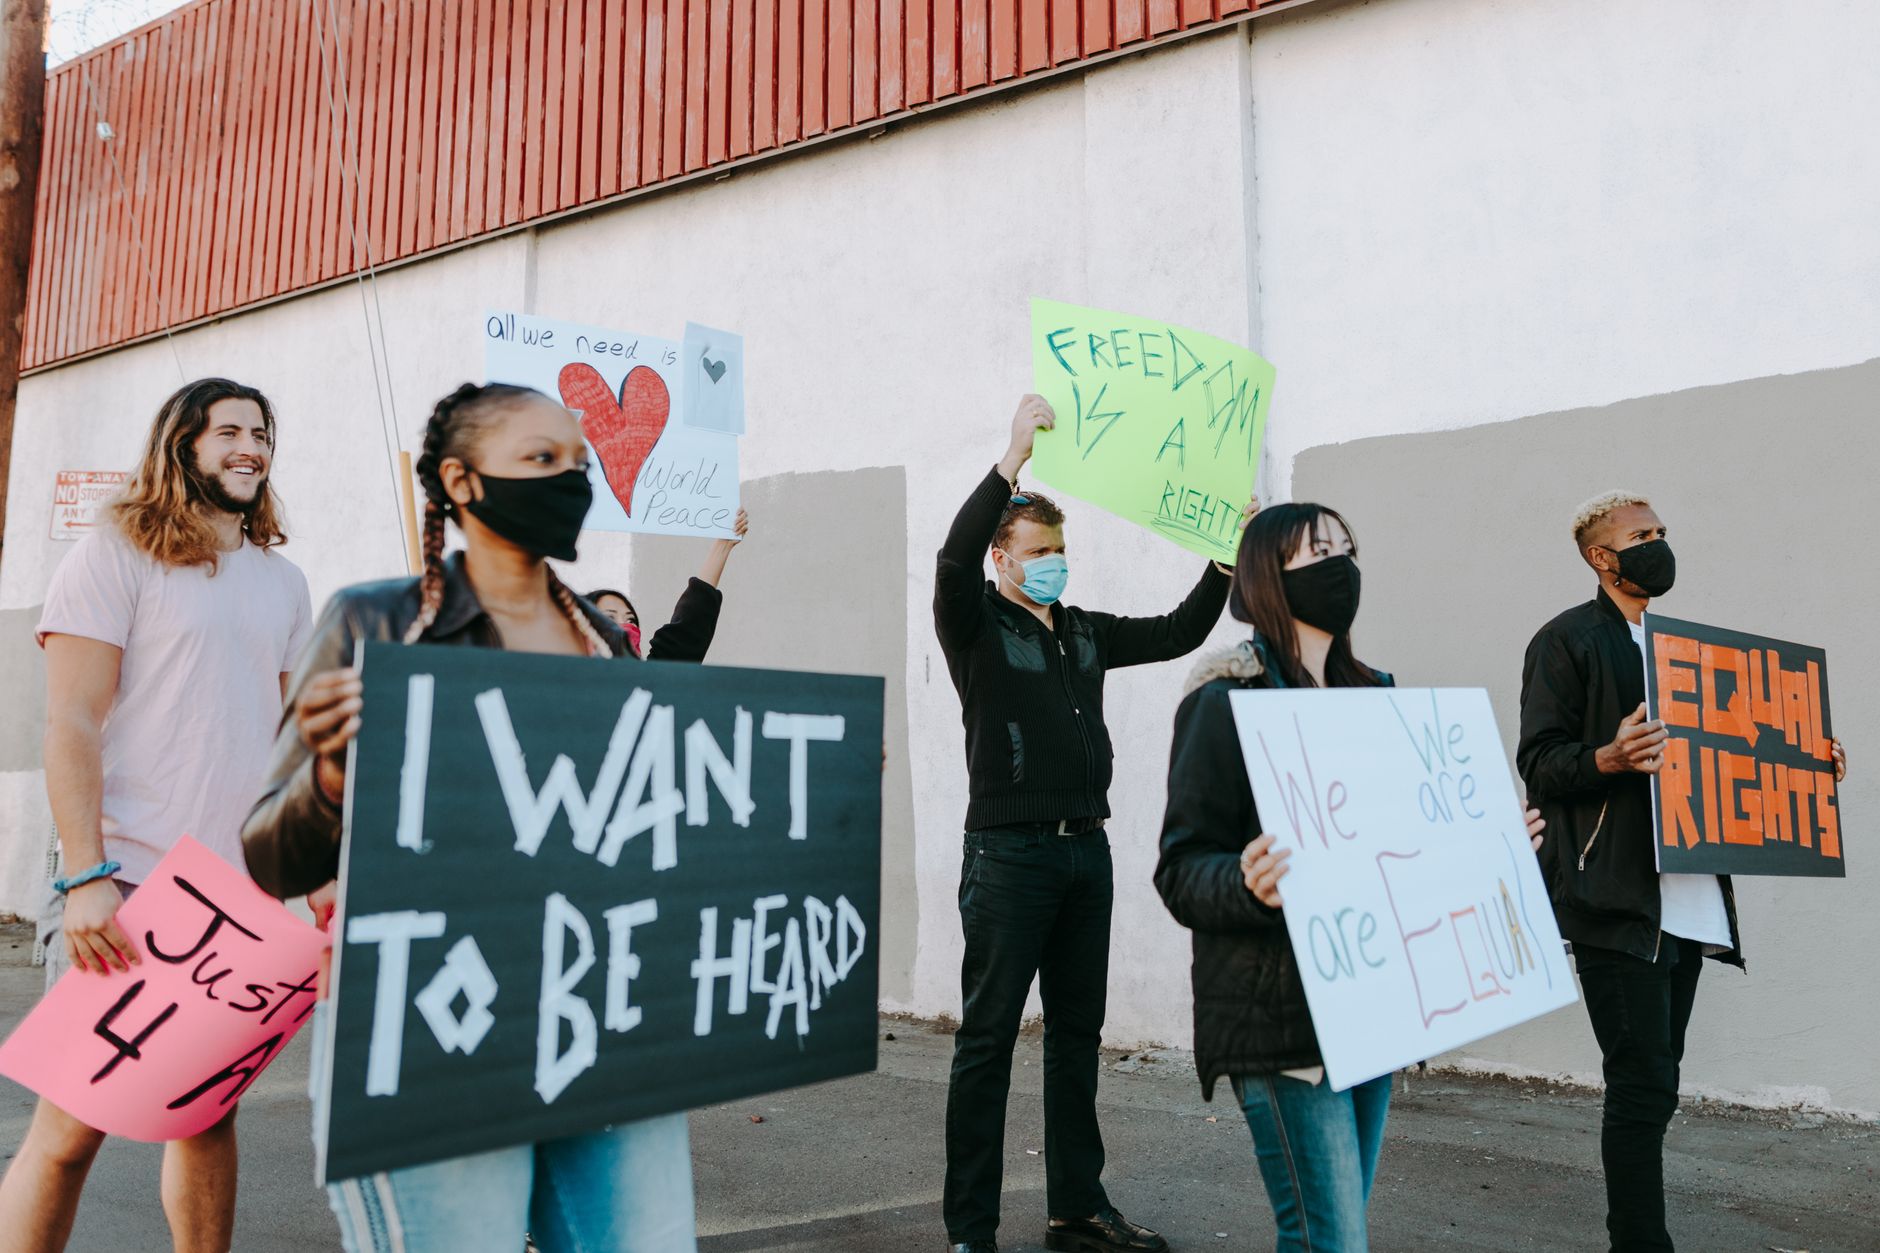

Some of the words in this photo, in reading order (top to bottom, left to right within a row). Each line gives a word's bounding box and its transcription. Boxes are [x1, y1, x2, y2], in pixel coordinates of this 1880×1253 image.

[487, 313, 514, 342] all
[522, 326, 554, 348] we
[576, 336, 637, 359] need
[661, 347, 677, 366] is
[1046, 327, 1260, 467] FREEDOM
[1071, 380, 1126, 461] IS
[1154, 416, 1185, 472] A
[56, 484, 78, 504] NO
[62, 507, 87, 519] ANY
[638, 457, 721, 499] World
[642, 490, 735, 530] Peace
[1386, 687, 1471, 774] We
[1653, 632, 1833, 762] EQUAL
[397, 673, 435, 853] I
[474, 687, 845, 872] WANT
[1257, 711, 1358, 850] We
[1418, 770, 1485, 824] are
[1658, 737, 1841, 859] RIGHTS
[145, 875, 318, 1024] Just
[1307, 906, 1387, 982] are
[90, 979, 178, 1085] 4
[347, 910, 499, 1097] TO
[534, 891, 658, 1105] BE
[690, 893, 867, 1041] HEARD
